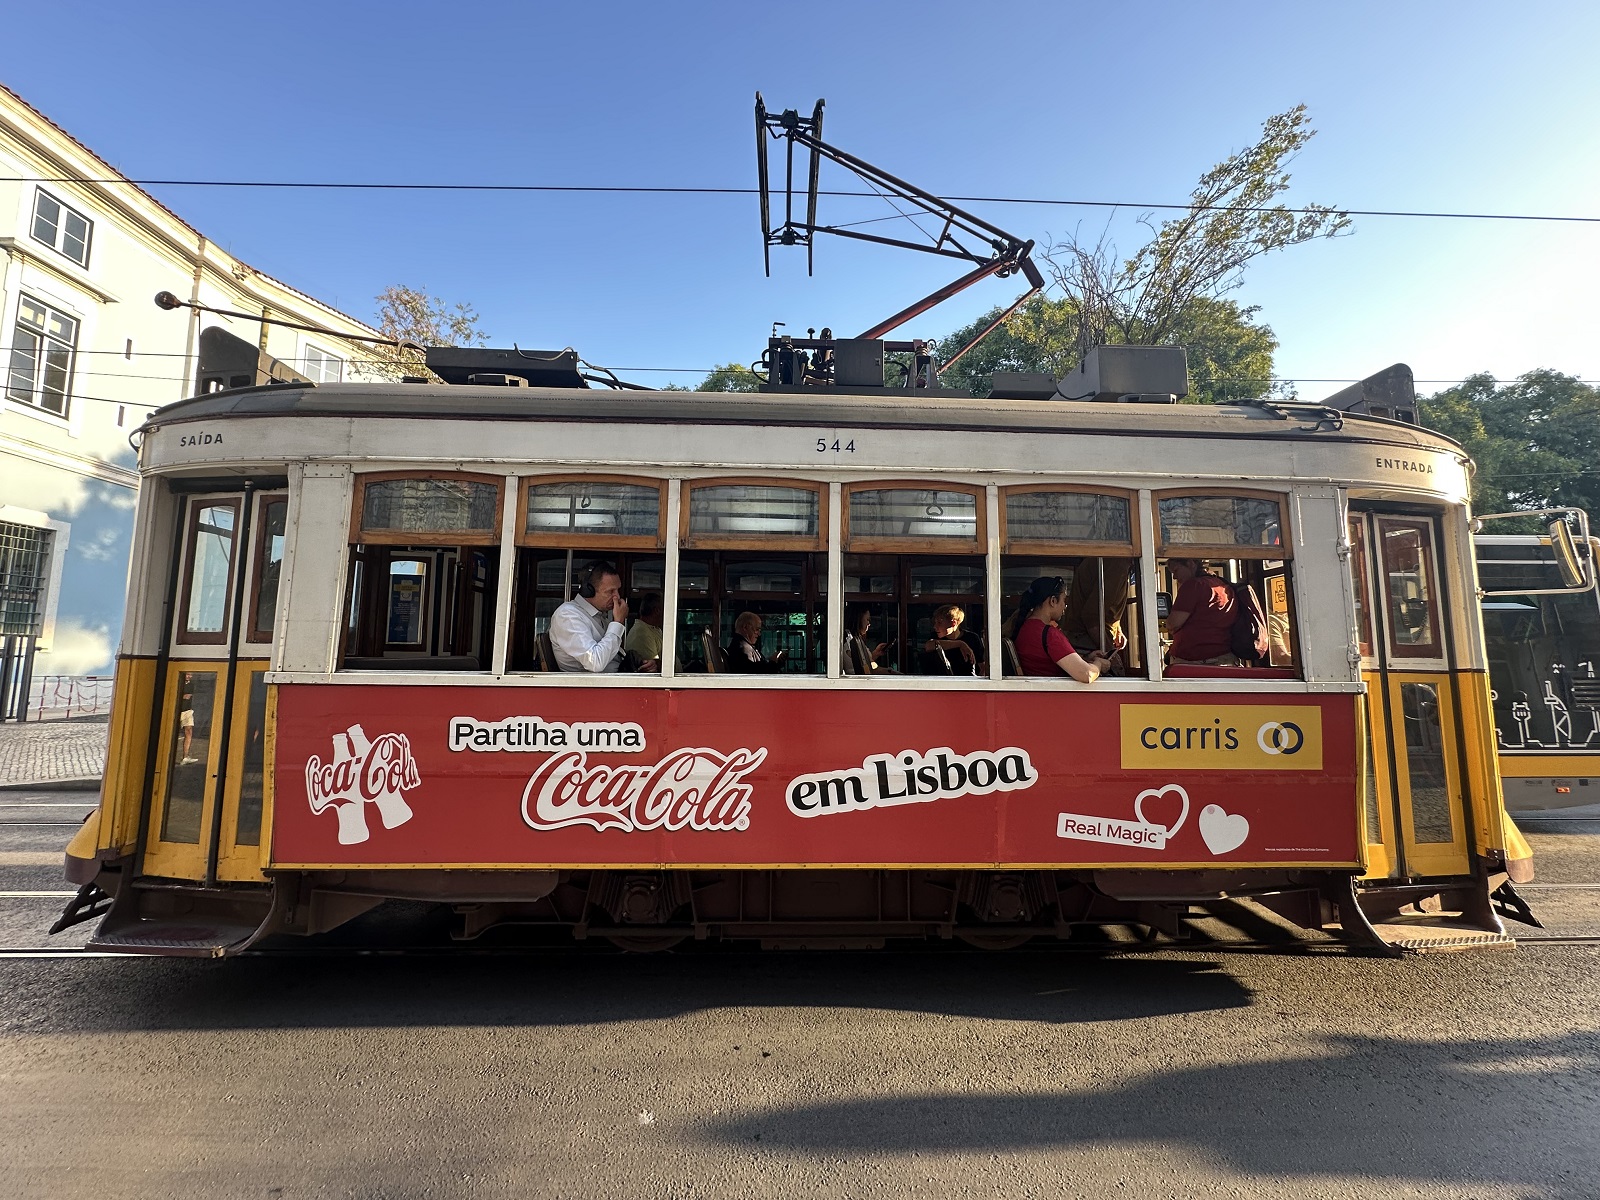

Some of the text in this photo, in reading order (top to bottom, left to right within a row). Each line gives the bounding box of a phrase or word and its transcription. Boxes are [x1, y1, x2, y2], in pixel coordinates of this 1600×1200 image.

[180, 431, 223, 447] SAÍDA
[816, 438, 856, 453] 544
[1376, 458, 1433, 474] ENTRADA
[455, 722, 641, 747] Partilha uma
[1140, 718, 1239, 750] carris
[306, 733, 421, 814] Coca-Cola
[791, 753, 1032, 811] em Lisboa
[1064, 819, 1102, 837] Real
